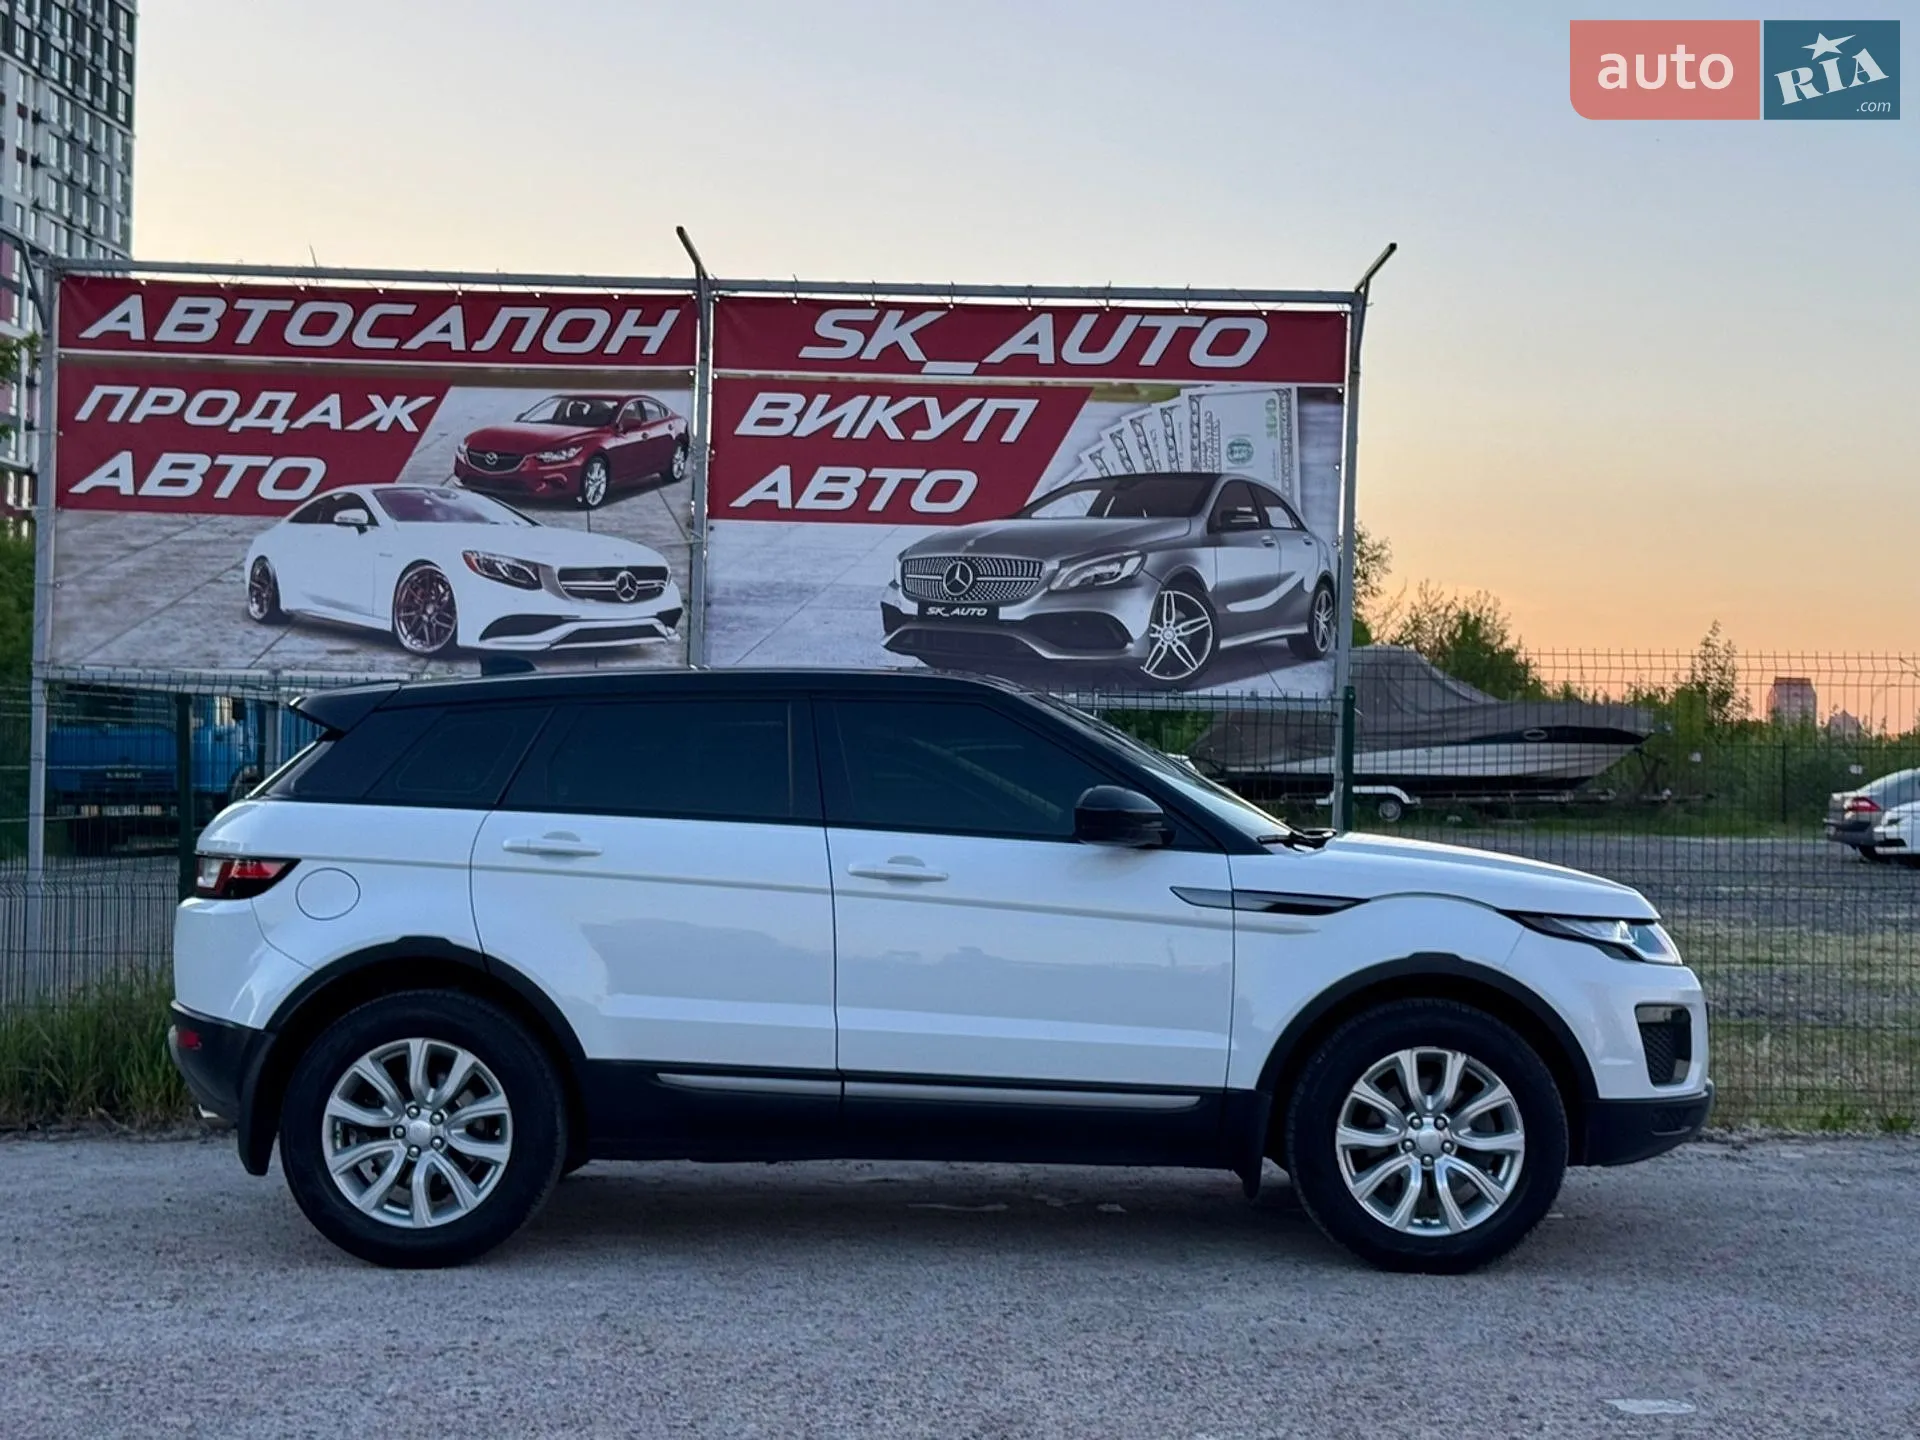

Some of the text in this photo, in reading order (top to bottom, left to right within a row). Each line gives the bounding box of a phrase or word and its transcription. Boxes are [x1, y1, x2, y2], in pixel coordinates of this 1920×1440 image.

[79, 293, 681, 356] АВТОСАЛОН
[798, 308, 1269, 375] SK_AUTO
[75, 384, 437, 435] ПРОДАЖ
[734, 391, 1040, 444] ВИКУП
[69, 450, 327, 502] АВТО
[729, 464, 979, 514] АВТО
[926, 606, 988, 617] SK_AUTO
